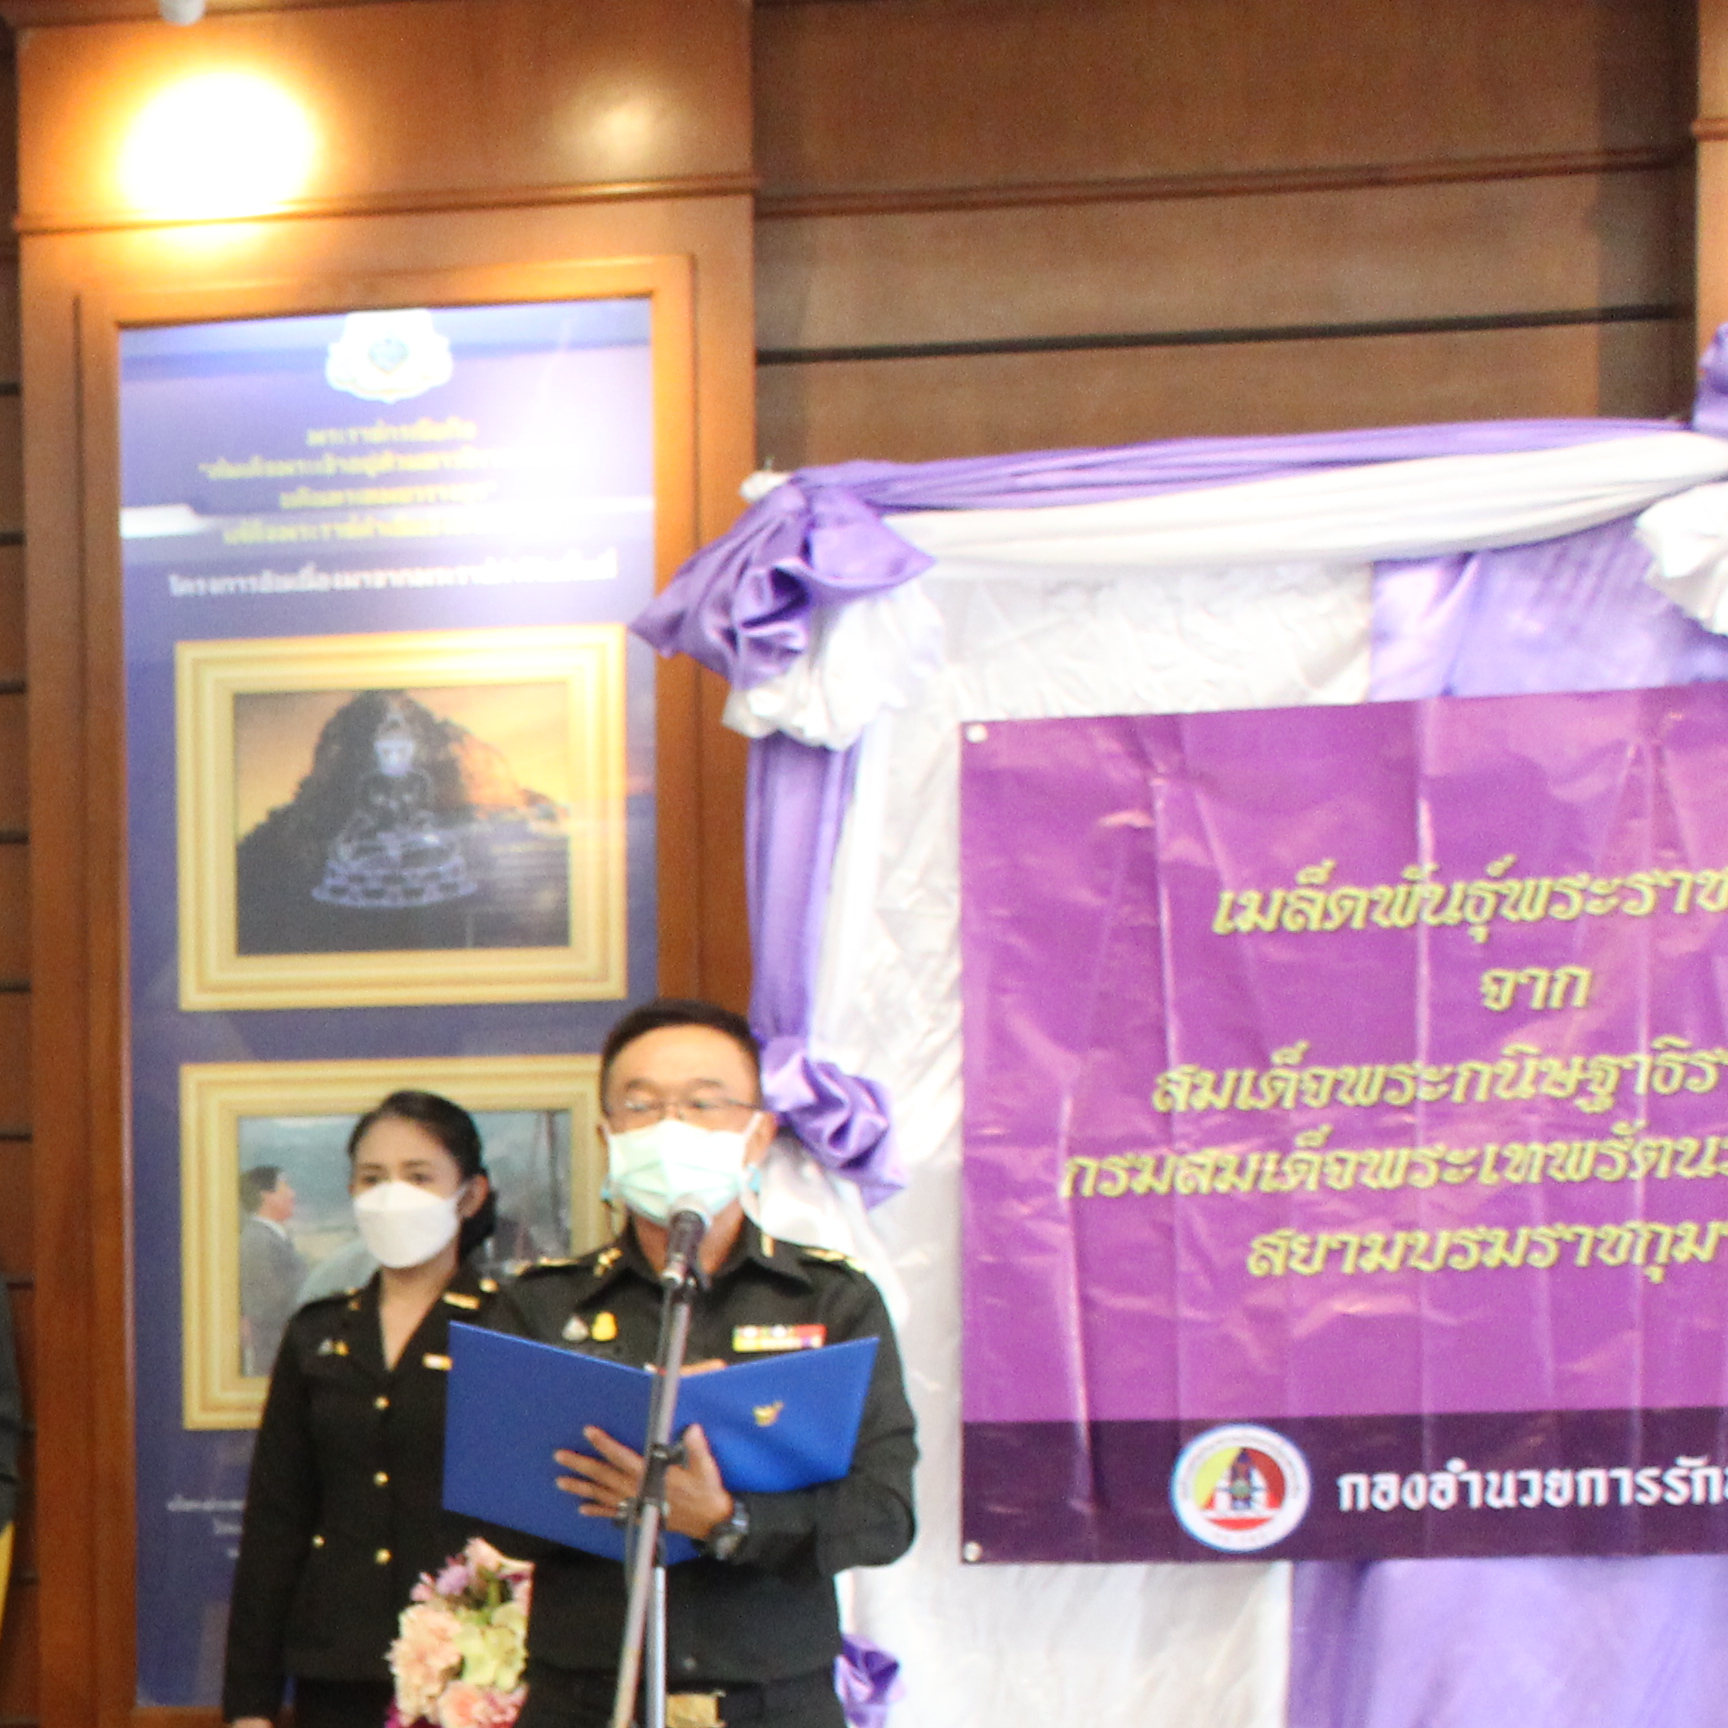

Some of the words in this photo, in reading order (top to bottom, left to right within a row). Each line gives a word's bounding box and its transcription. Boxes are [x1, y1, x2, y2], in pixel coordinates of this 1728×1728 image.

[1479, 964, 1594, 1011] จาก
[1058, 1119, 1728, 1198] กรมสมเด็จพระเทพรัตน
[1246, 1219, 1728, 1284] สยามบรมราชกุม
[1337, 1454, 1728, 1512] กองอำนวยการรัก
